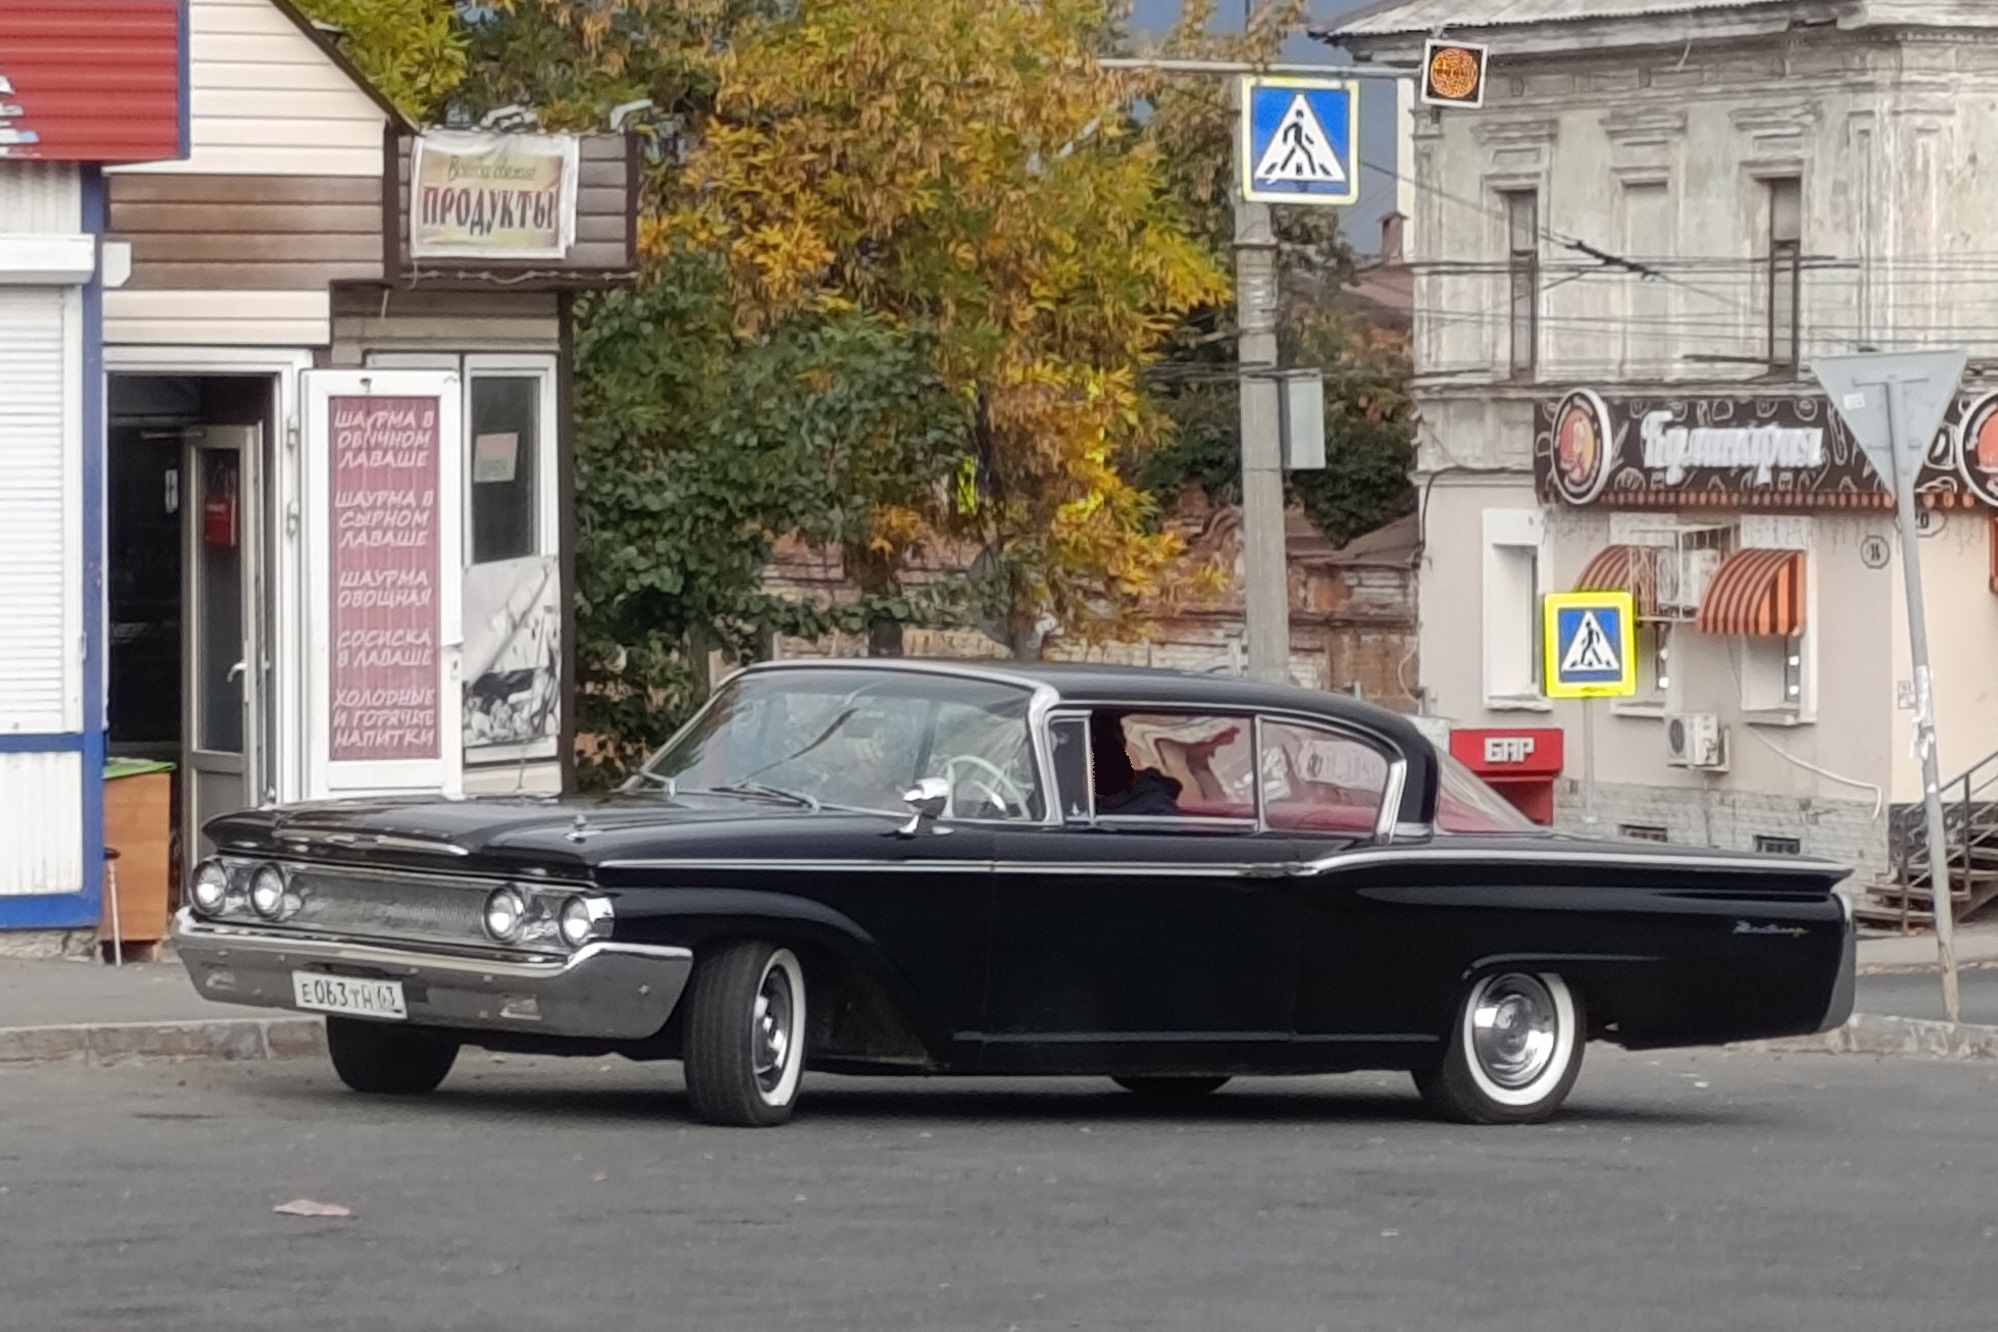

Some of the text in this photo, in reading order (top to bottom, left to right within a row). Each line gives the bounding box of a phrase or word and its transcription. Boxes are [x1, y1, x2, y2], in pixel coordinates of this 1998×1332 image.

[422, 187, 554, 236] ПРОДУКТЫ
[334, 410, 435, 428] ШАУРМА В
[337, 430, 432, 448] ОБЫЧНОМ
[338, 450, 429, 469] ЛАВАШЕ
[334, 488, 435, 508] ШАУРМА В
[338, 509, 431, 528] СЫРНОМ
[338, 528, 429, 548] ЛАВАШЕ
[338, 569, 429, 588] ШАУРМА
[337, 588, 432, 608] ОВОЩНАЯ
[336, 629, 432, 649] СОСИСКА
[337, 648, 432, 668] В ЛАВАШЕ
[333, 687, 435, 709] ХОЛОДНЫЕ
[333, 710, 347, 728] И
[333, 729, 435, 748] НАПИТКИ
[1484, 737, 1534, 763] БАР
